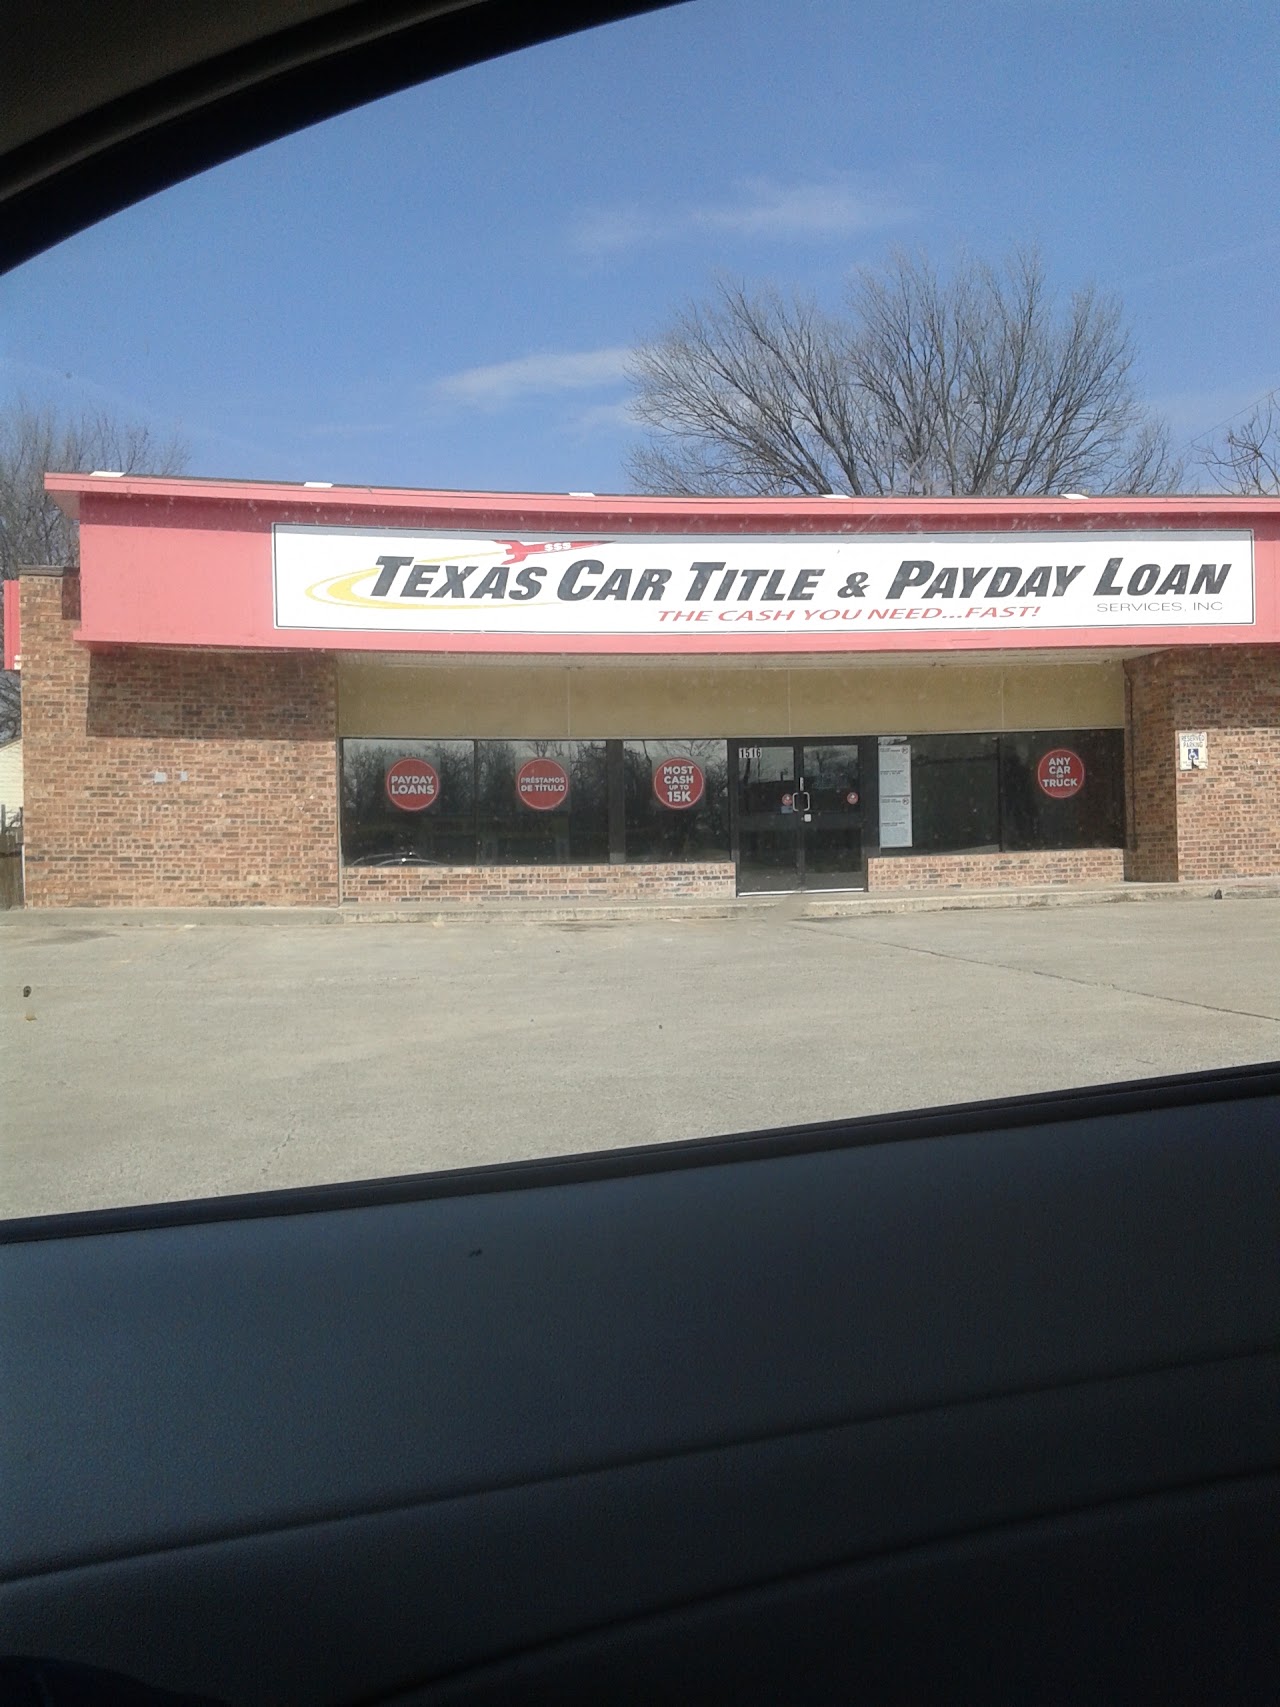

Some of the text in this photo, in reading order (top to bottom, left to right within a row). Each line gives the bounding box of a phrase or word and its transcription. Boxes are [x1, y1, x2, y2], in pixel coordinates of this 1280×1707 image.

[370, 555, 1232, 602] TEXAS CAR TITLE & PAYDAY LOAN
[657, 610, 719, 622] THE
[723, 609, 794, 622] CASH
[804, 608, 862, 621] YOU
[740, 748, 761, 758] 1516
[1049, 757, 1071, 766] ANY
[663, 766, 694, 775] MOST
[1049, 766, 1071, 774] CAR
[391, 775, 434, 785] PAYDAY
[664, 775, 694, 784] CASH
[1042, 778, 1078, 787] TRUCK
[391, 785, 435, 795] LOANS
[520, 784, 533, 792] DE
[667, 791, 691, 802] 15K
